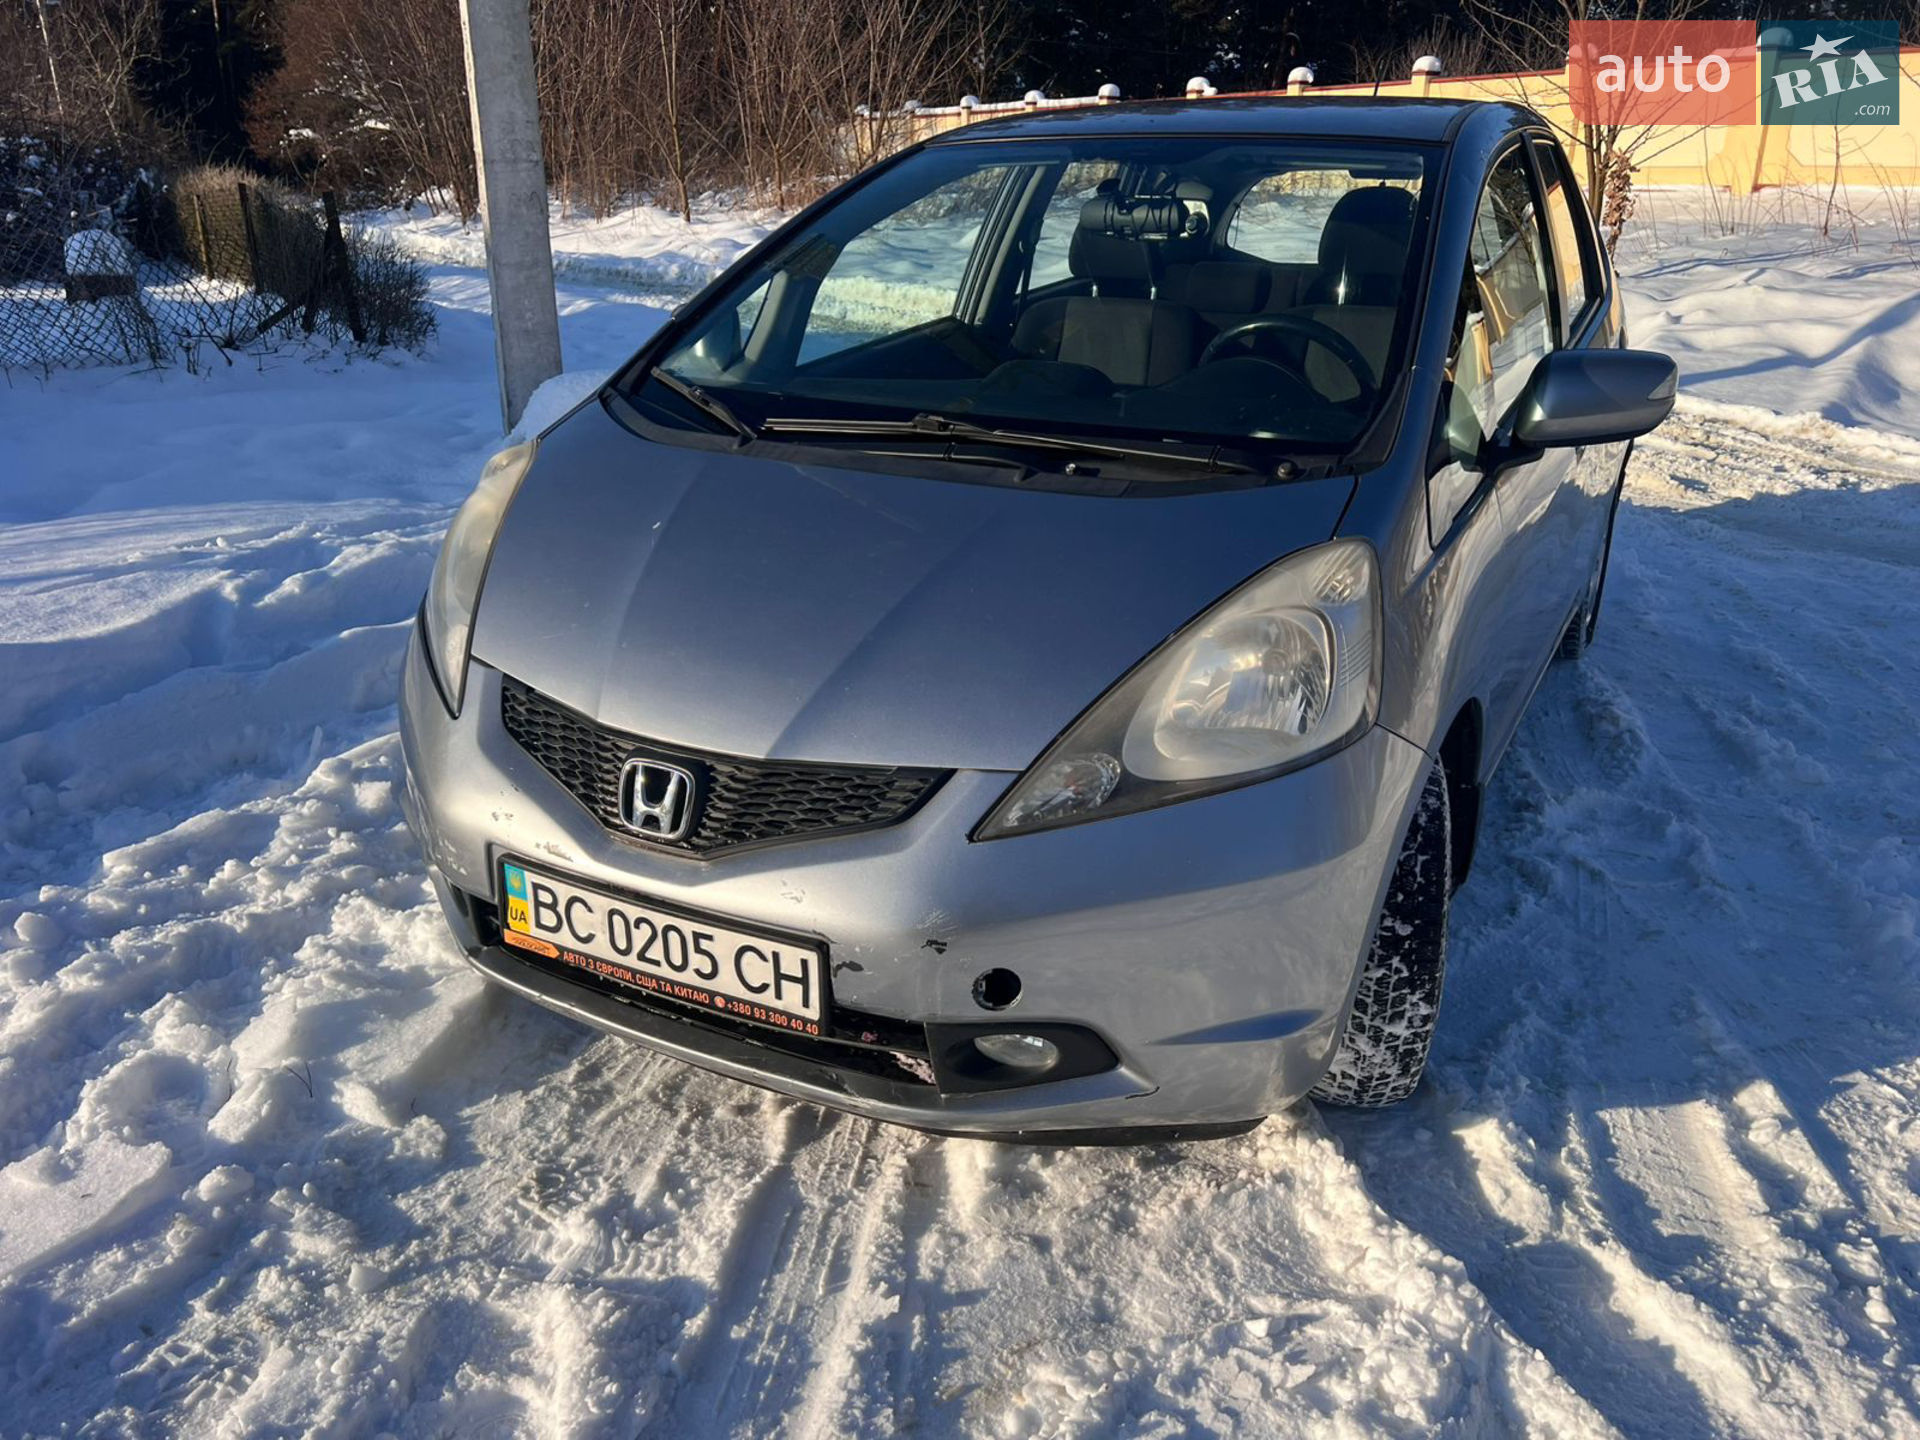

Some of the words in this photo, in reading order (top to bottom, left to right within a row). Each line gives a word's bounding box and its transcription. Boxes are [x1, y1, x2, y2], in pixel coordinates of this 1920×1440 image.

[509, 907, 528, 925] UA
[607, 907, 719, 980] 0205
[563, 950, 587, 967] АВТО
[660, 980, 673, 994] ТА
[673, 984, 709, 1004] КИТАЮ
[727, 1001, 751, 1016] +380
[753, 1006, 766, 1020] 93
[768, 1011, 788, 1026] 300
[790, 1018, 803, 1031] 40
[805, 1024, 819, 1036] 40
